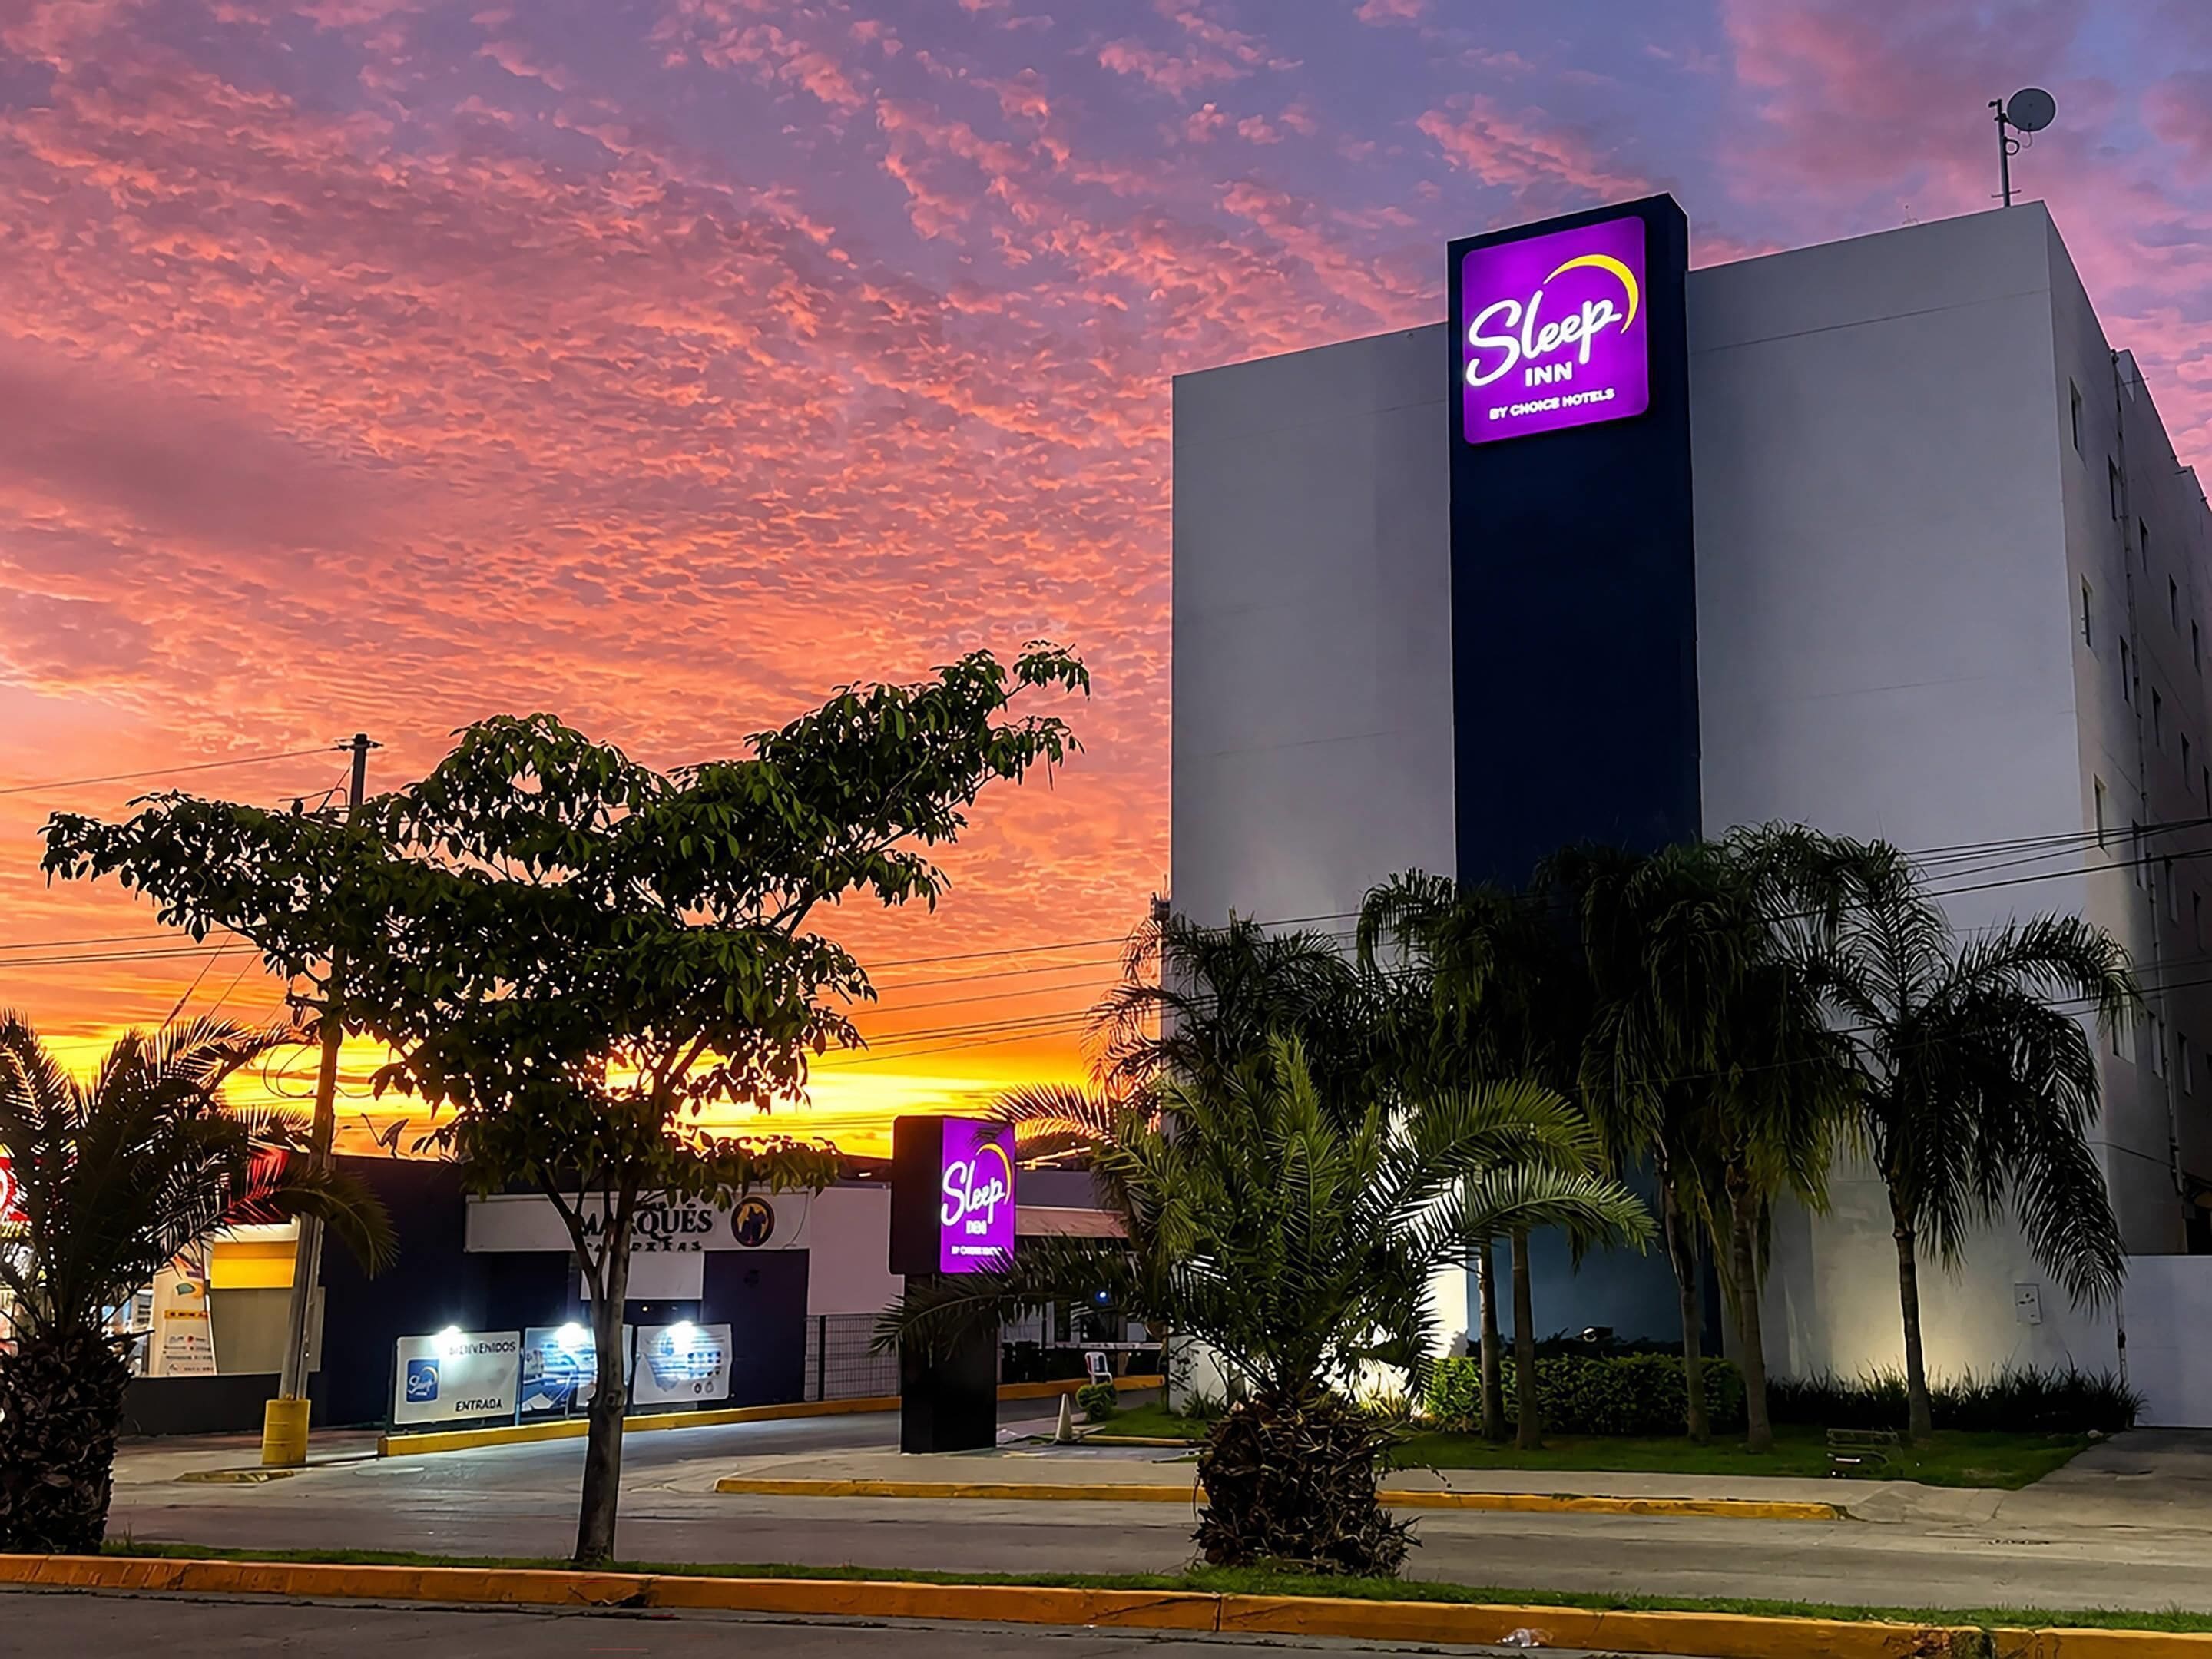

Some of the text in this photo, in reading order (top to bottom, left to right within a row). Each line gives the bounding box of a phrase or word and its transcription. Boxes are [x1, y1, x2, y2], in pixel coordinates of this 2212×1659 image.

[1465, 290, 1623, 386] Sleep
[1525, 361, 1573, 387] INN
[1489, 388, 1615, 420] BY CHOICE HOTELS
[941, 1160, 1006, 1227] Sleep
[455, 1399, 503, 1412] ENTRADA
